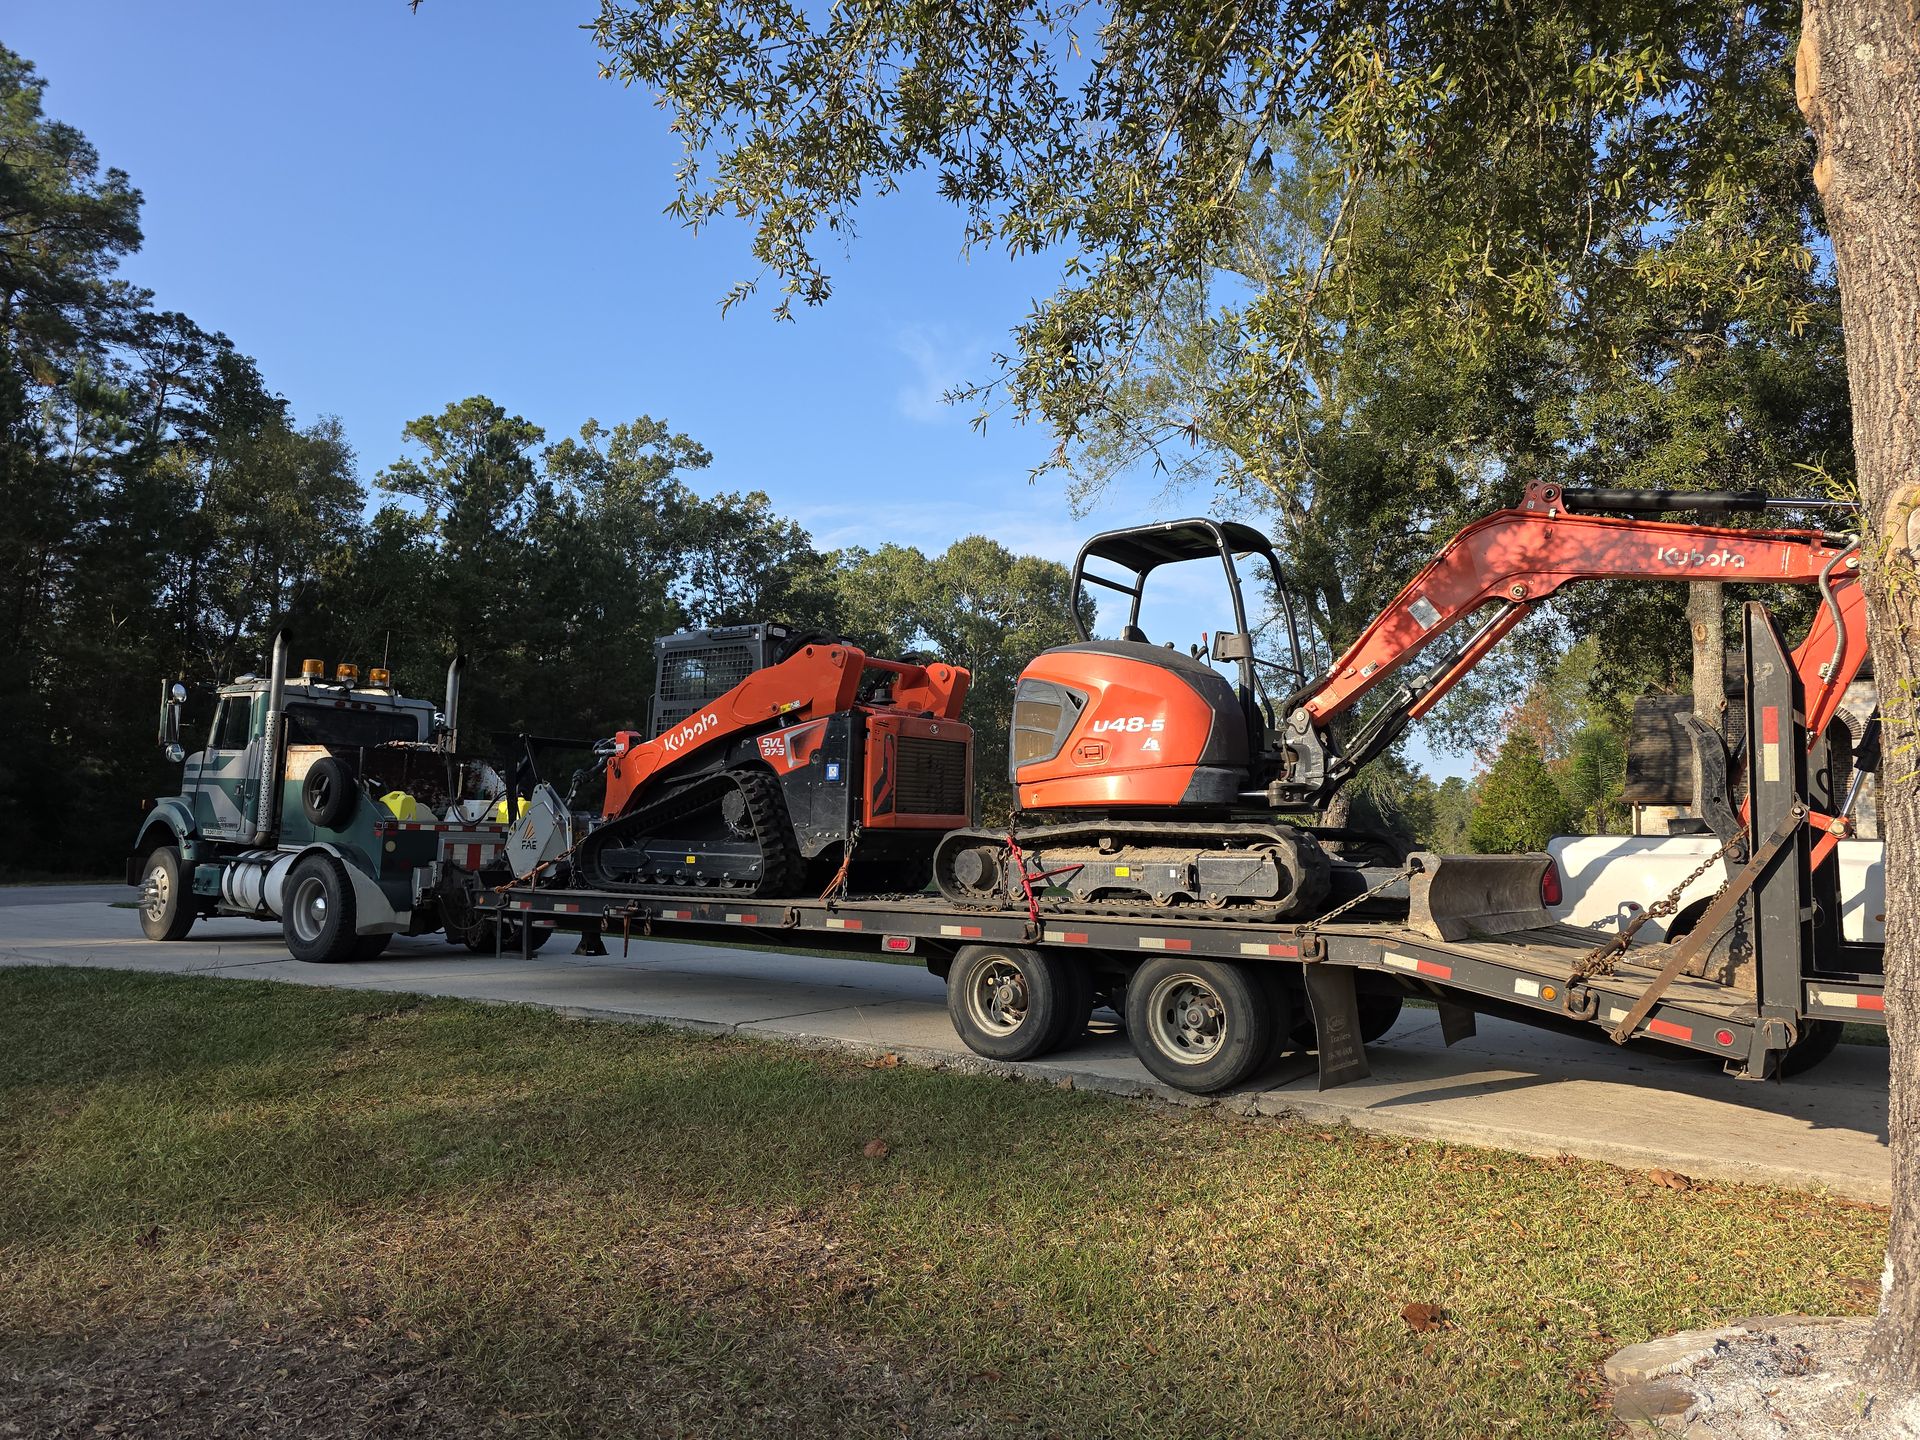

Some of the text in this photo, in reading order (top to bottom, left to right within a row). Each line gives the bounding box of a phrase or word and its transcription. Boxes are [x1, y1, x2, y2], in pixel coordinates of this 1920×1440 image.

[1657, 547, 1745, 568] Kubota
[664, 713, 719, 751] Kubota
[761, 738, 785, 748] SVL
[764, 748, 785, 756] 97-3
[521, 840, 537, 850] FAE
